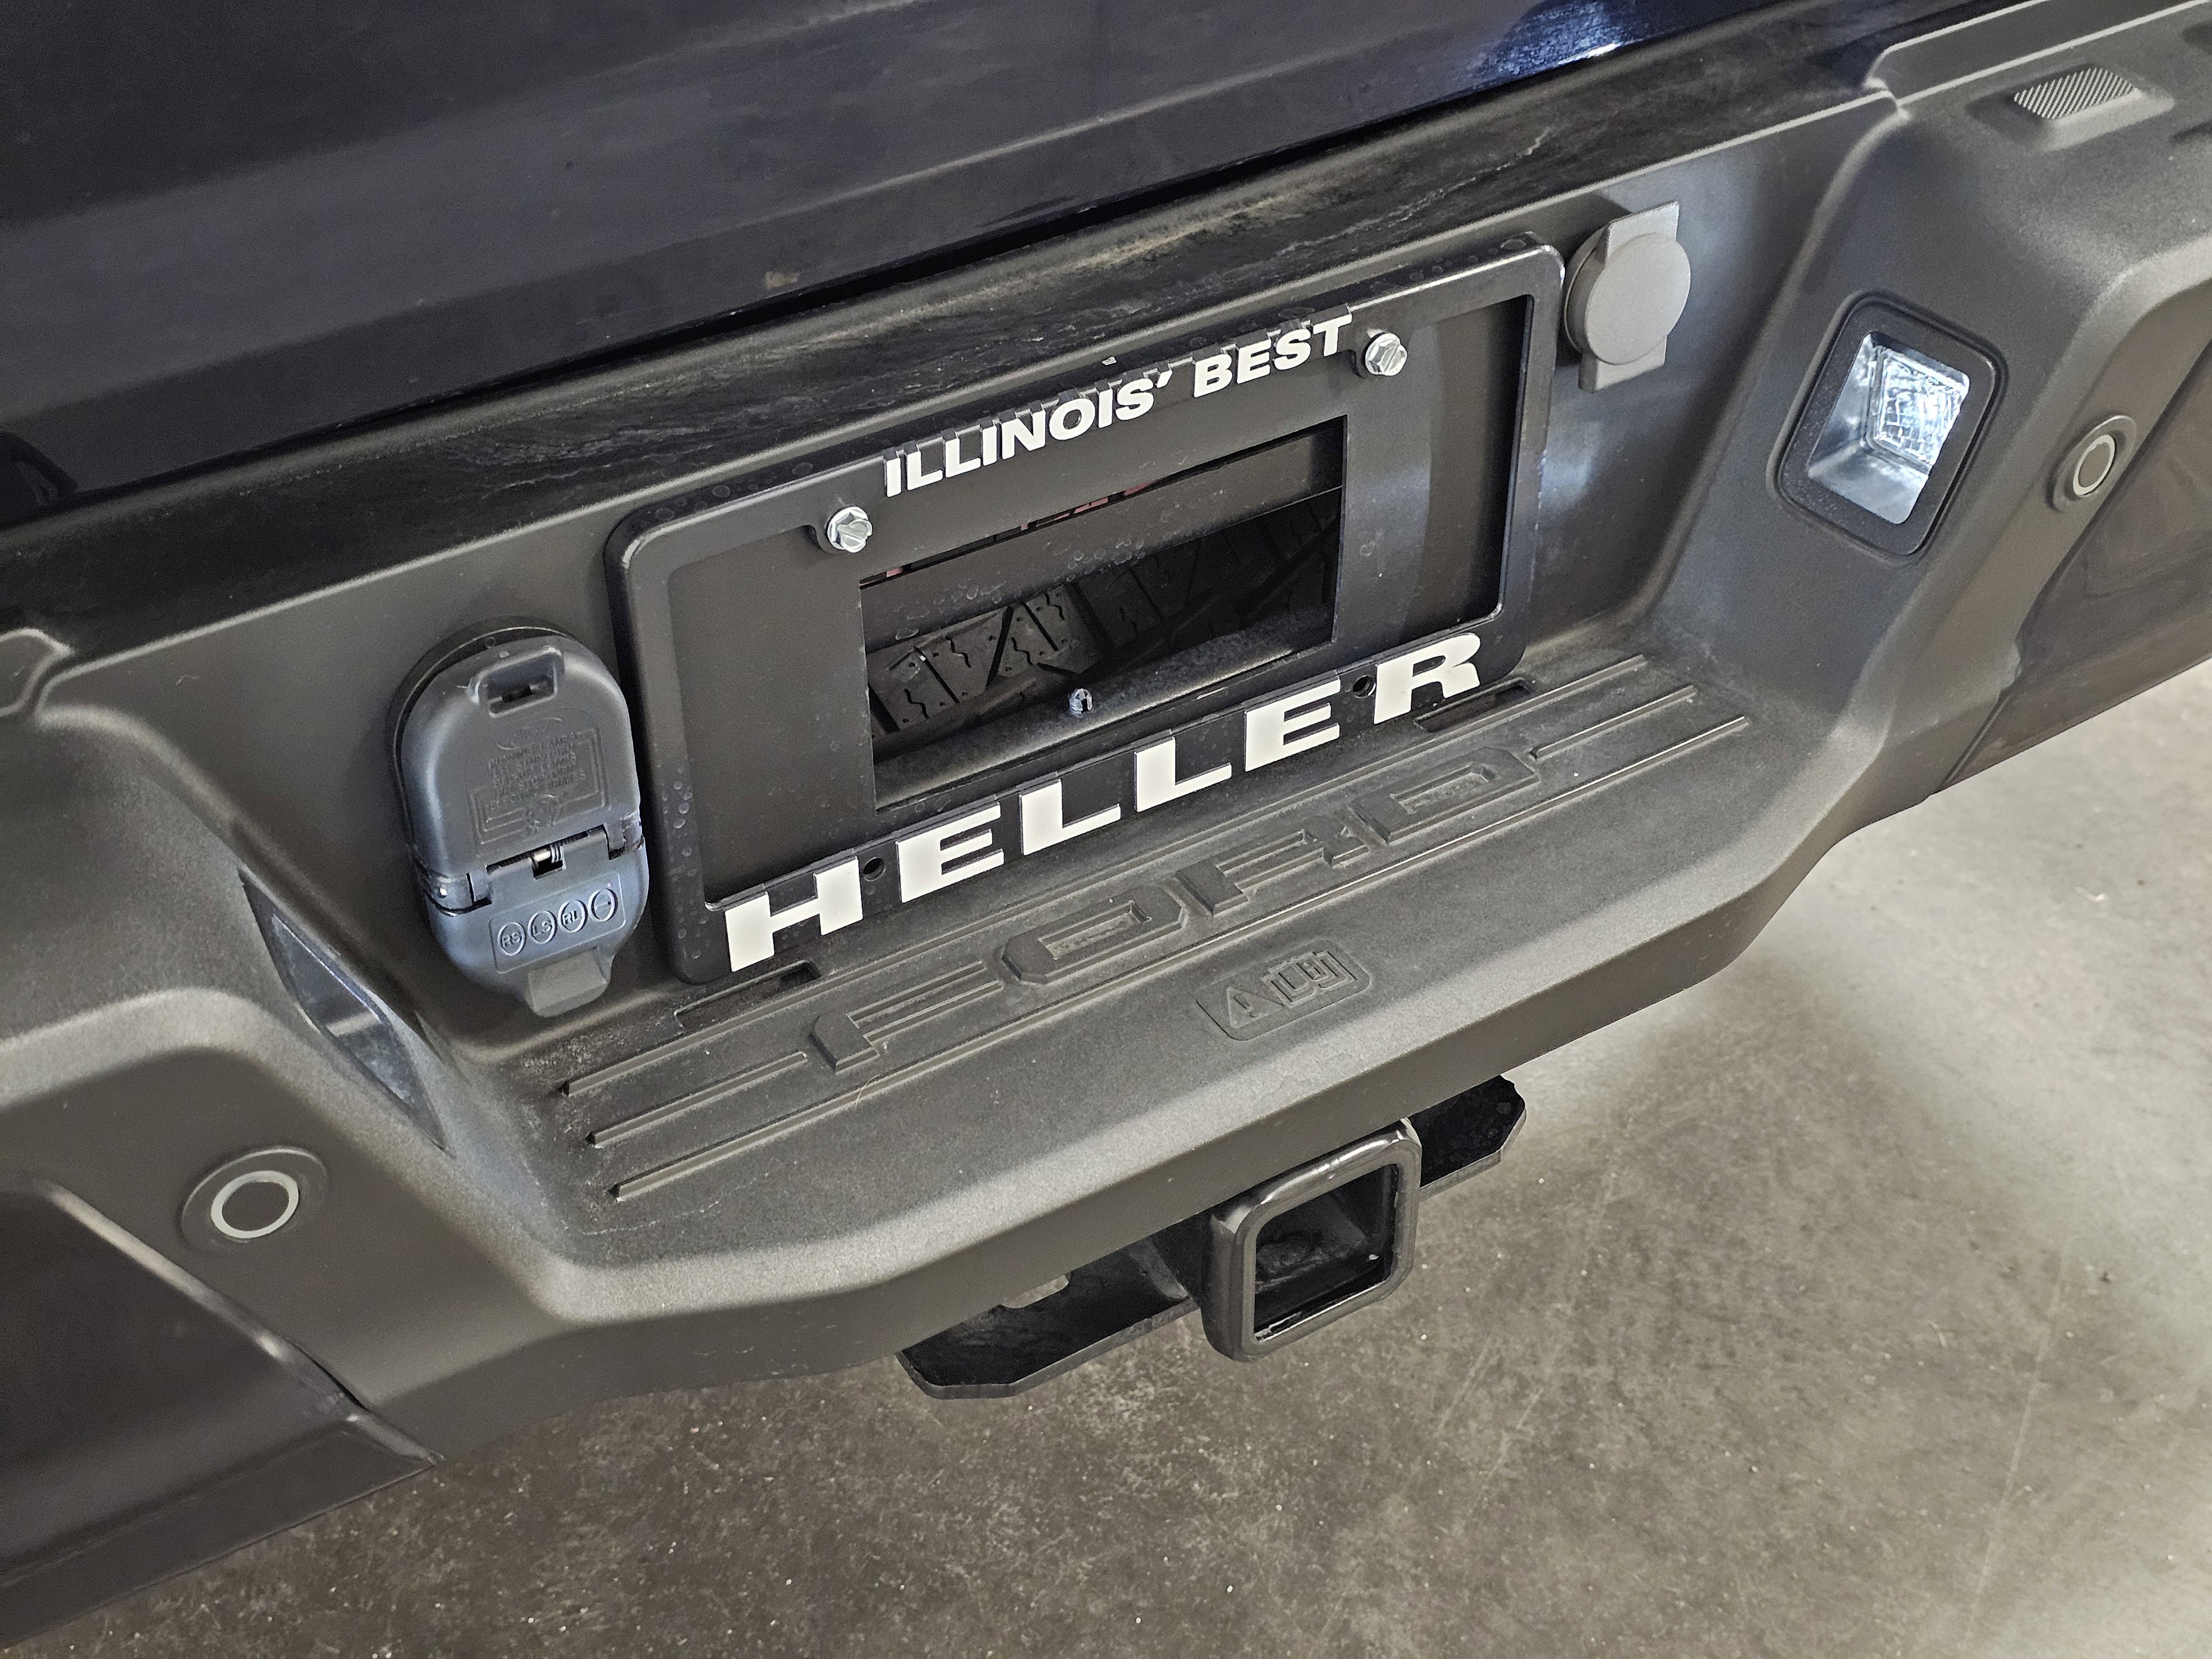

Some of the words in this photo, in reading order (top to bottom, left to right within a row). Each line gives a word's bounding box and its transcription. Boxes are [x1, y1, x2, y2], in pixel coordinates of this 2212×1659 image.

[1192, 314, 1353, 398] BEST
[725, 632, 1481, 972] HELLER
[502, 931, 523, 948] RS
[533, 920, 553, 937] LS
[811, 746, 1541, 1071] FORD
